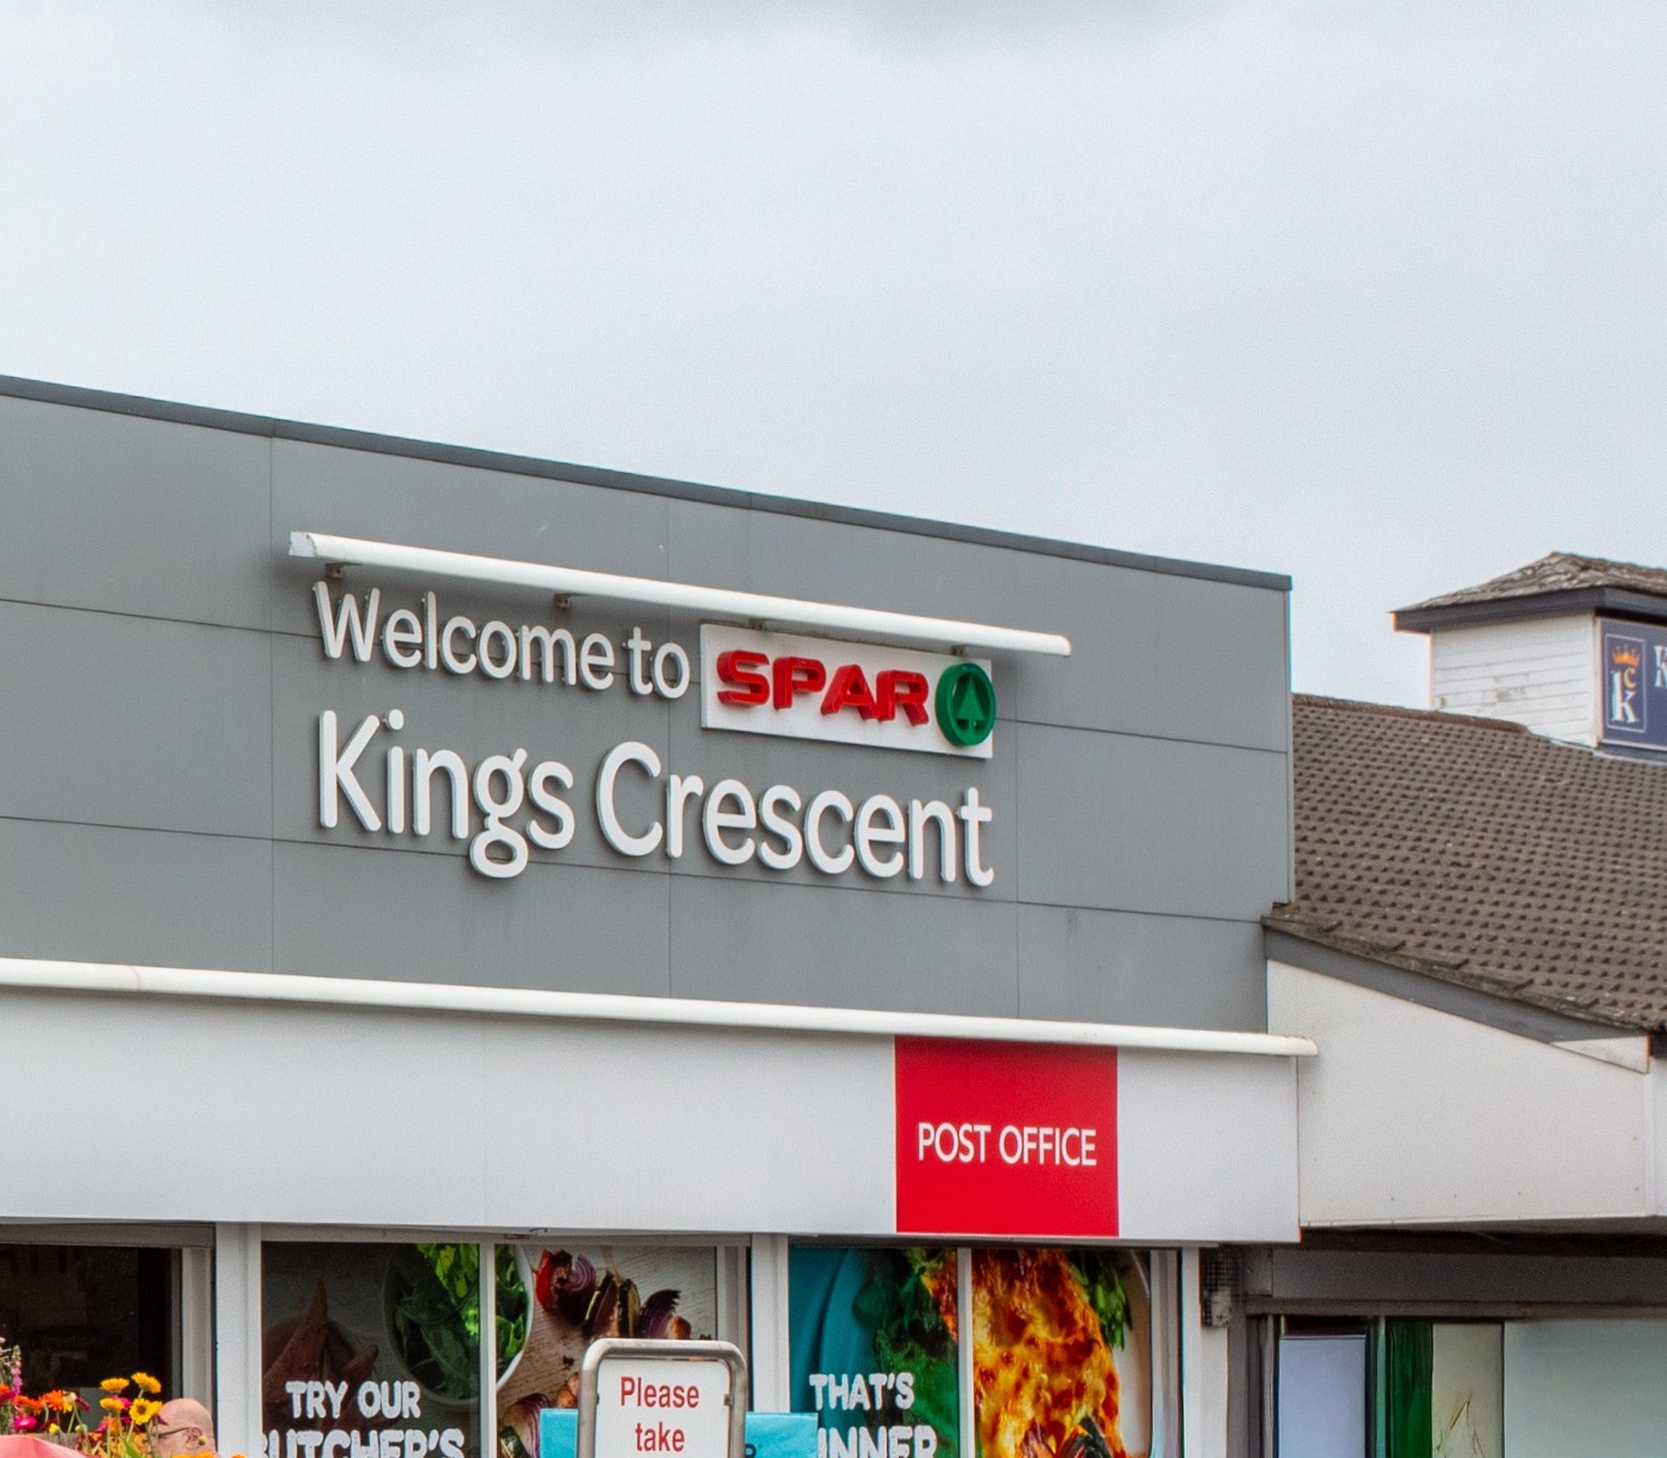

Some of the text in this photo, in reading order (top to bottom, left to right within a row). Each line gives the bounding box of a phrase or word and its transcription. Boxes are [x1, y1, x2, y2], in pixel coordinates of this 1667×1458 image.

[313, 581, 929, 726] Welcome to SPAR
[319, 709, 995, 887] Kings Crescent
[918, 1122, 1097, 1166] POST OFFICE
[285, 1379, 421, 1419] TRY OUR
[620, 1376, 700, 1409] Please
[809, 1372, 915, 1410] THAT'S
[635, 1421, 685, 1453] take
